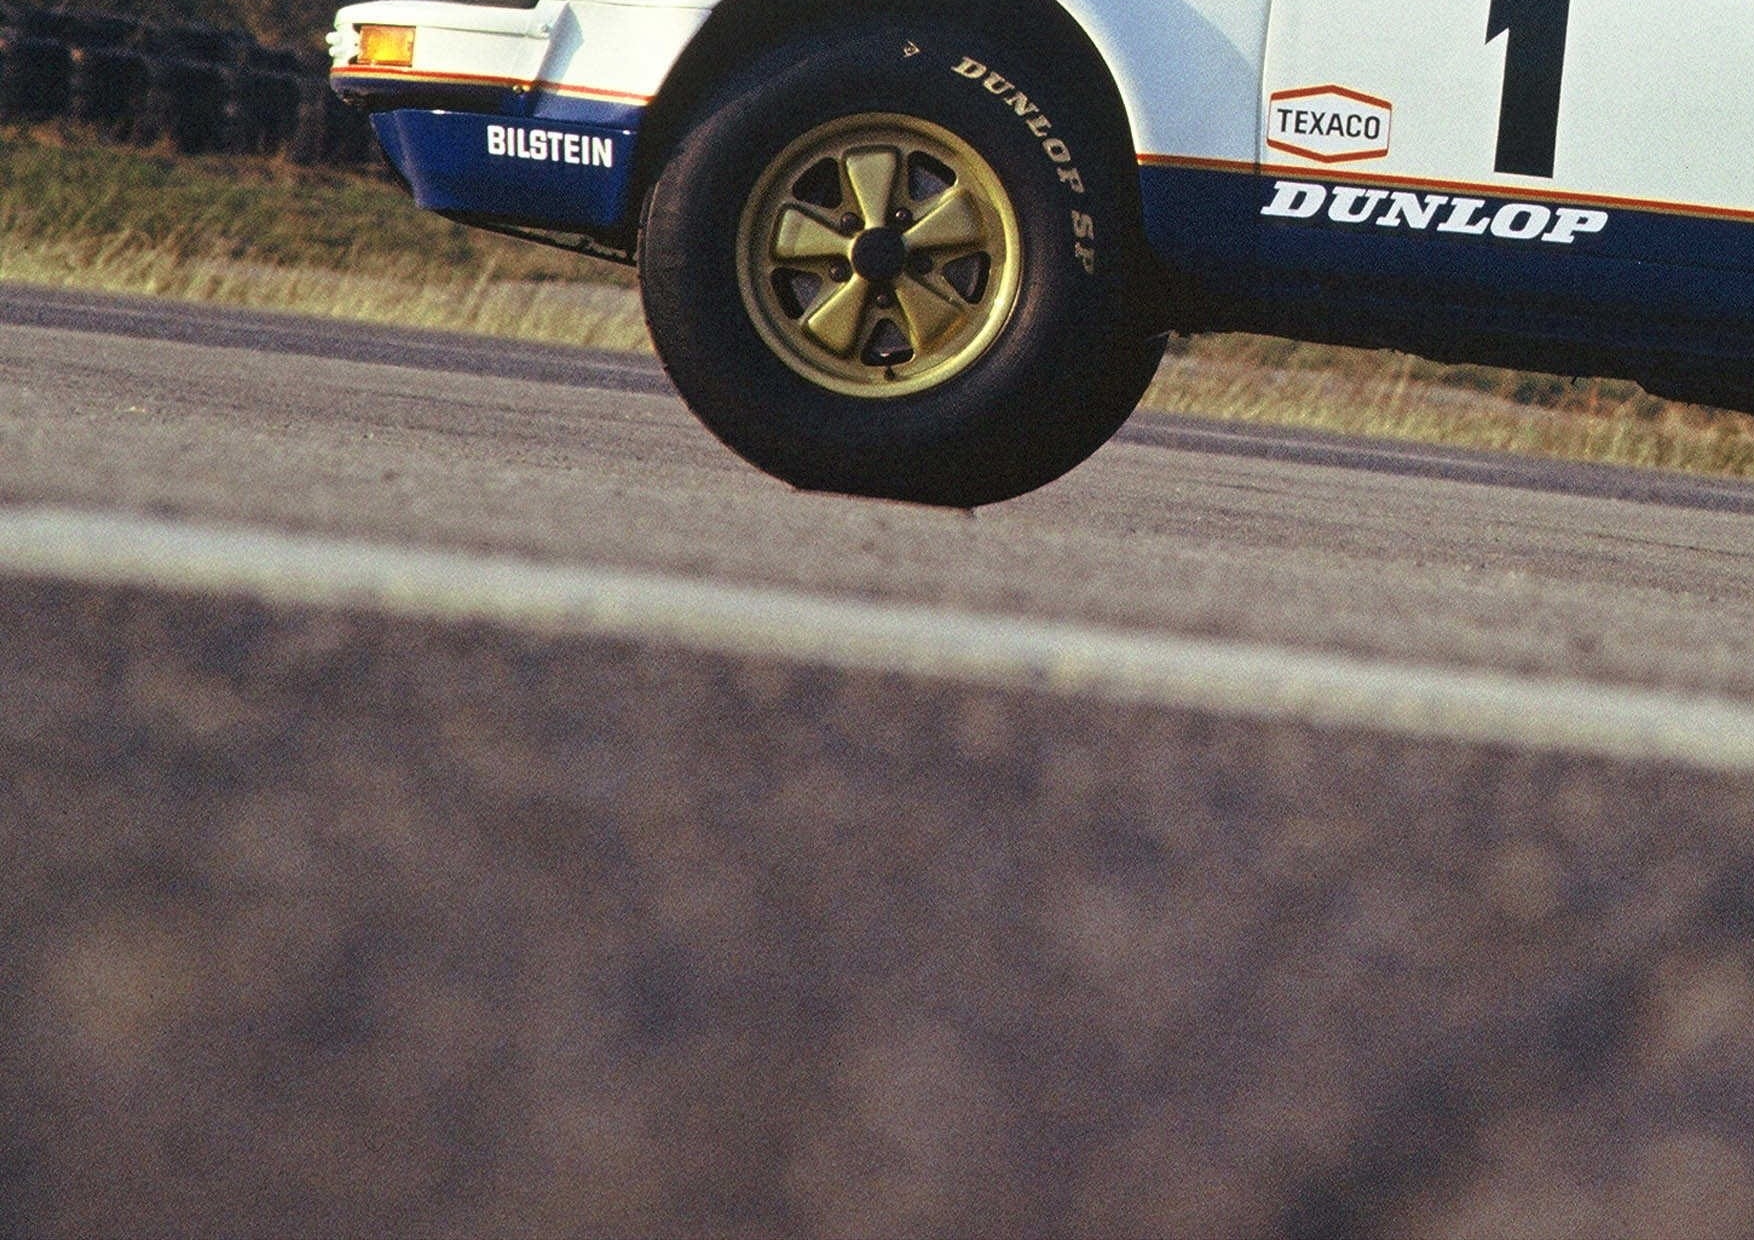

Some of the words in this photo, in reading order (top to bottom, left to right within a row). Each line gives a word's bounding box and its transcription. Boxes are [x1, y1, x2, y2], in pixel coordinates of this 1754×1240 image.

[487, 124, 612, 168] BILSTEIN
[951, 56, 1086, 193] DUNLOP
[1277, 108, 1381, 141] TEXACO
[1261, 181, 1608, 244] DUNLOP
